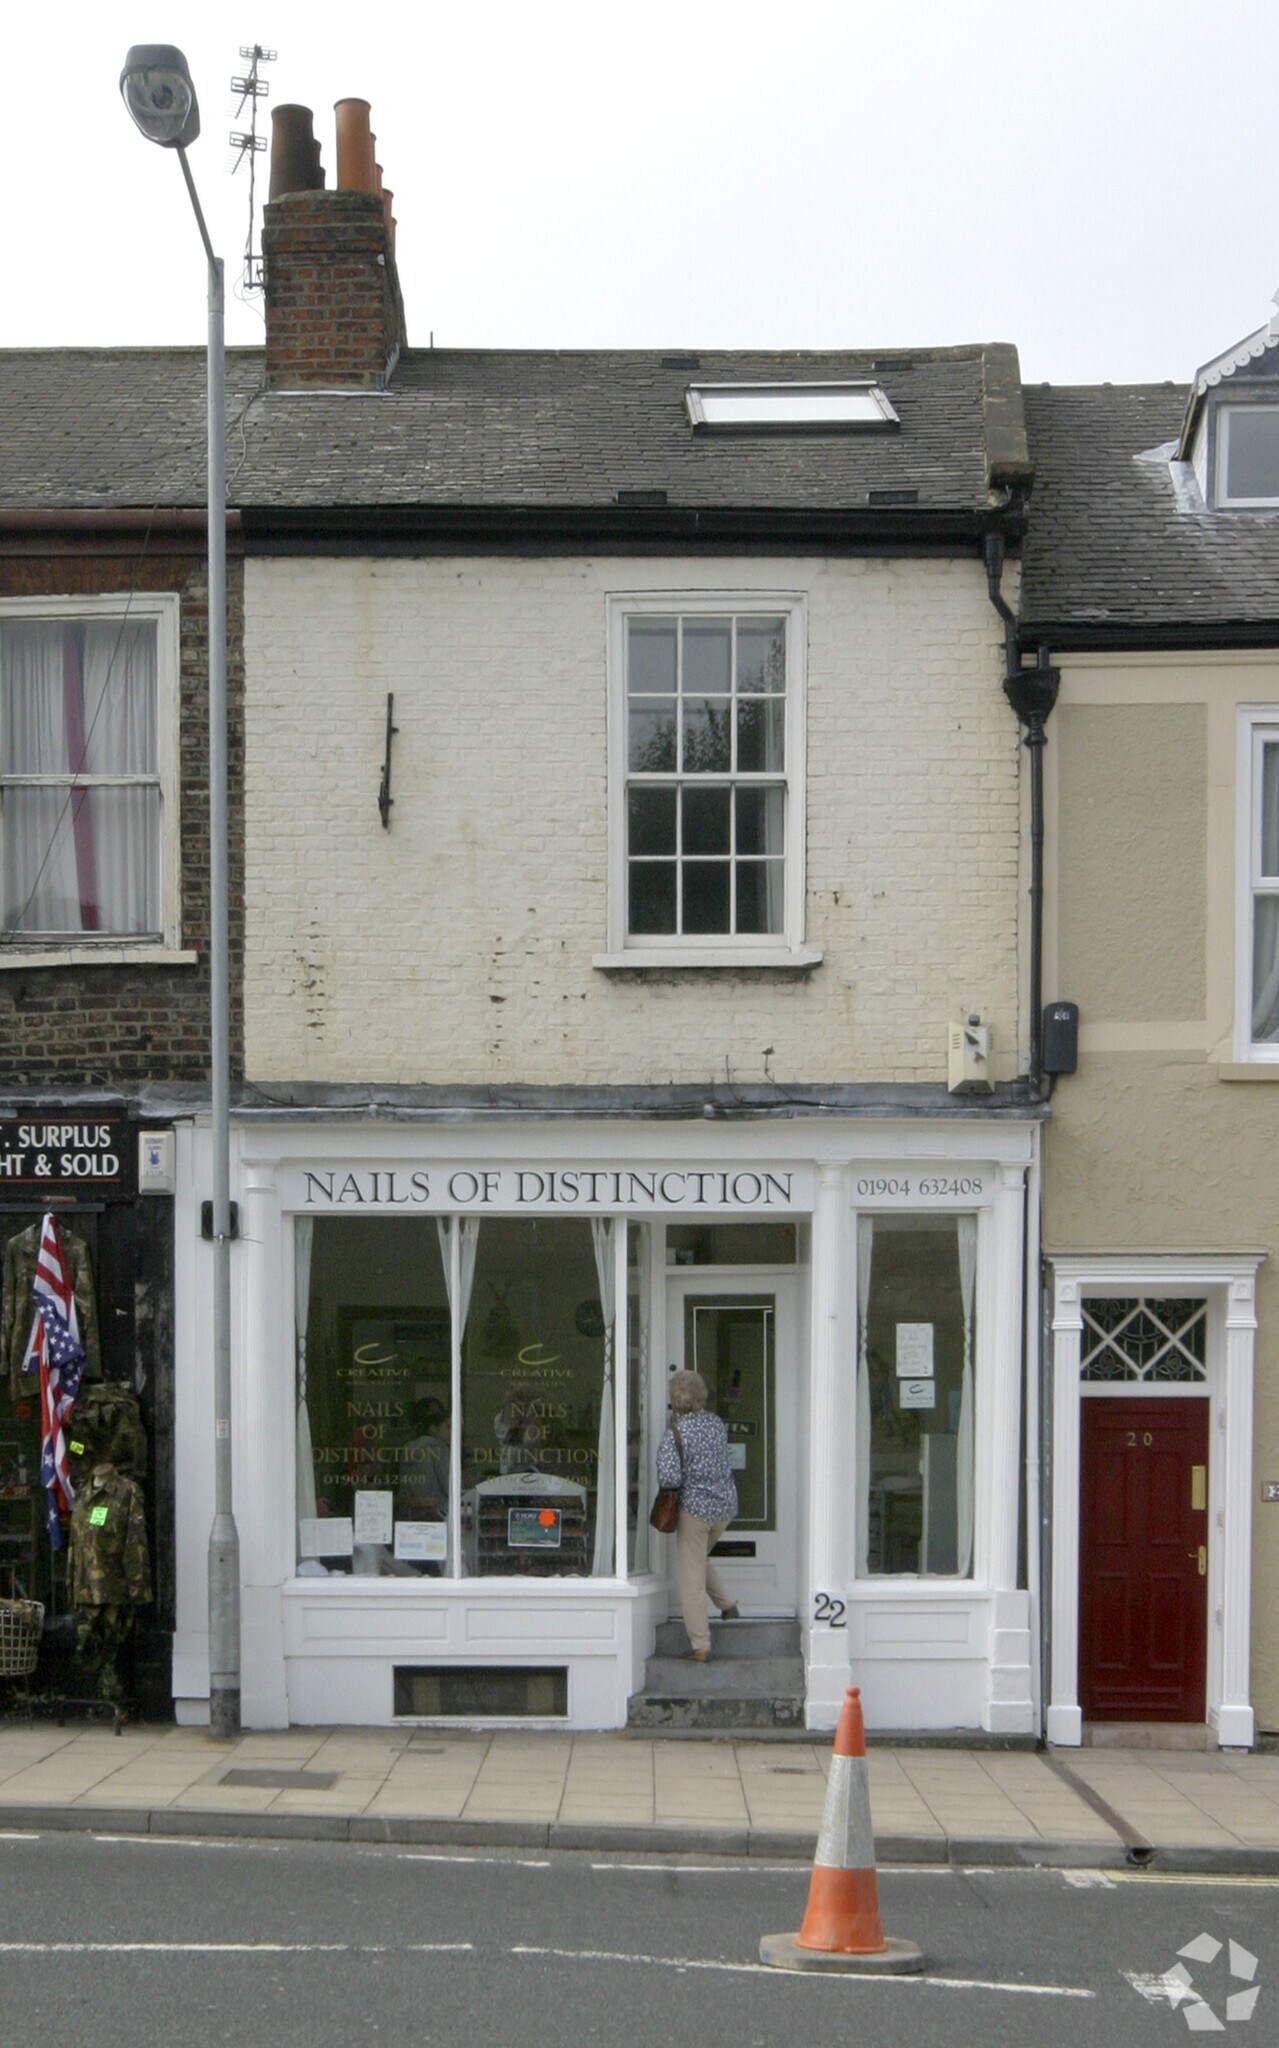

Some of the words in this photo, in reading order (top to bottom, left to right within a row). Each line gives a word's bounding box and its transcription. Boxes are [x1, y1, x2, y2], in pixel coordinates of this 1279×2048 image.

[18, 1125, 111, 1148] SURPLUS
[34, 1153, 52, 1176] &
[60, 1153, 120, 1176] SOLD
[303, 1171, 430, 1203] NAILS
[448, 1171, 502, 1203] OF
[513, 1171, 794, 1204] DISTINCTION
[857, 1179, 910, 1196] 01904
[918, 1178, 983, 1196] 632408
[336, 1368, 410, 1377] CREATIVE
[500, 1368, 574, 1378] CREATIVE
[347, 1402, 404, 1418] NAILS
[511, 1402, 567, 1418] NAILS
[362, 1424, 387, 1440] OF
[525, 1424, 551, 1440] OF
[1127, 1432, 1152, 1447] 20
[311, 1447, 441, 1463] DISTINCTION
[814, 1593, 846, 1627] 22
